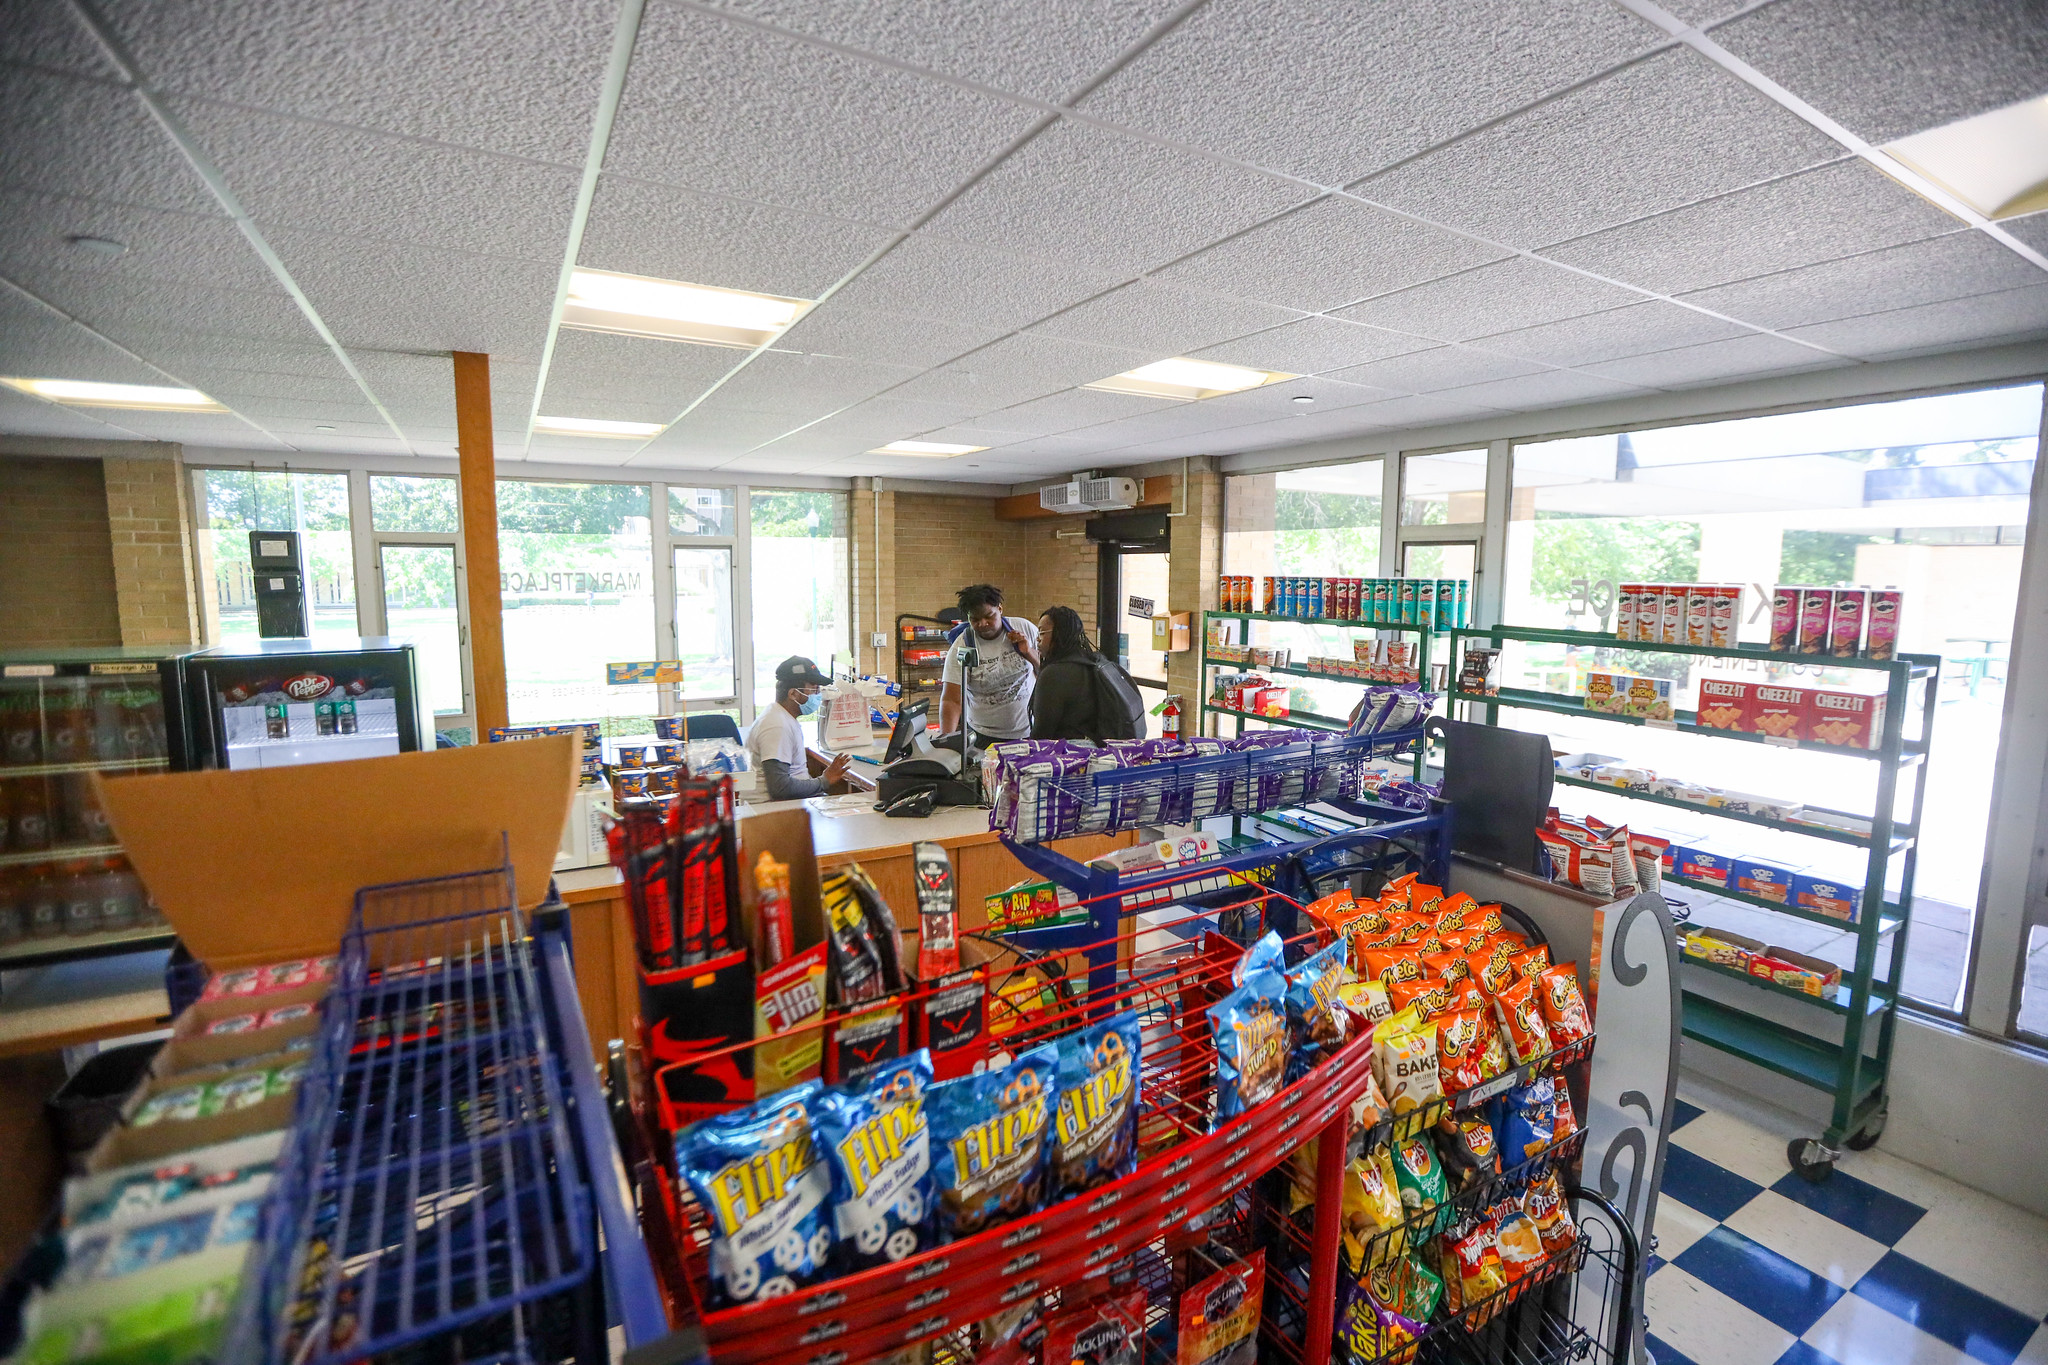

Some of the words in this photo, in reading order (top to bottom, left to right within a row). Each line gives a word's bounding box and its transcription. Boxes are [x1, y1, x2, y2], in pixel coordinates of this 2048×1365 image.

[293, 679, 328, 698] Pepper
[304, 677, 317, 687] Dr
[1703, 681, 1747, 698] CHEEZ-IT
[1756, 686, 1803, 704] CHEEZ-IT
[1815, 693, 1866, 712] CHEEZ-IT
[1012, 891, 1031, 911] Rip
[762, 953, 822, 988] ORIGINAL
[1358, 1002, 1392, 1020] AKED
[1396, 1054, 1437, 1078] BAKE
[1056, 1057, 1131, 1147] Flipz
[955, 1096, 1046, 1185] Flipz
[1468, 1125, 1492, 1148] Lay's
[840, 1098, 926, 1199] Flipz
[1404, 1142, 1426, 1172] ay's
[710, 1133, 814, 1238] Flipz
[1489, 1196, 1523, 1227] RUFFL
[1071, 1339, 1097, 1359] JACK
